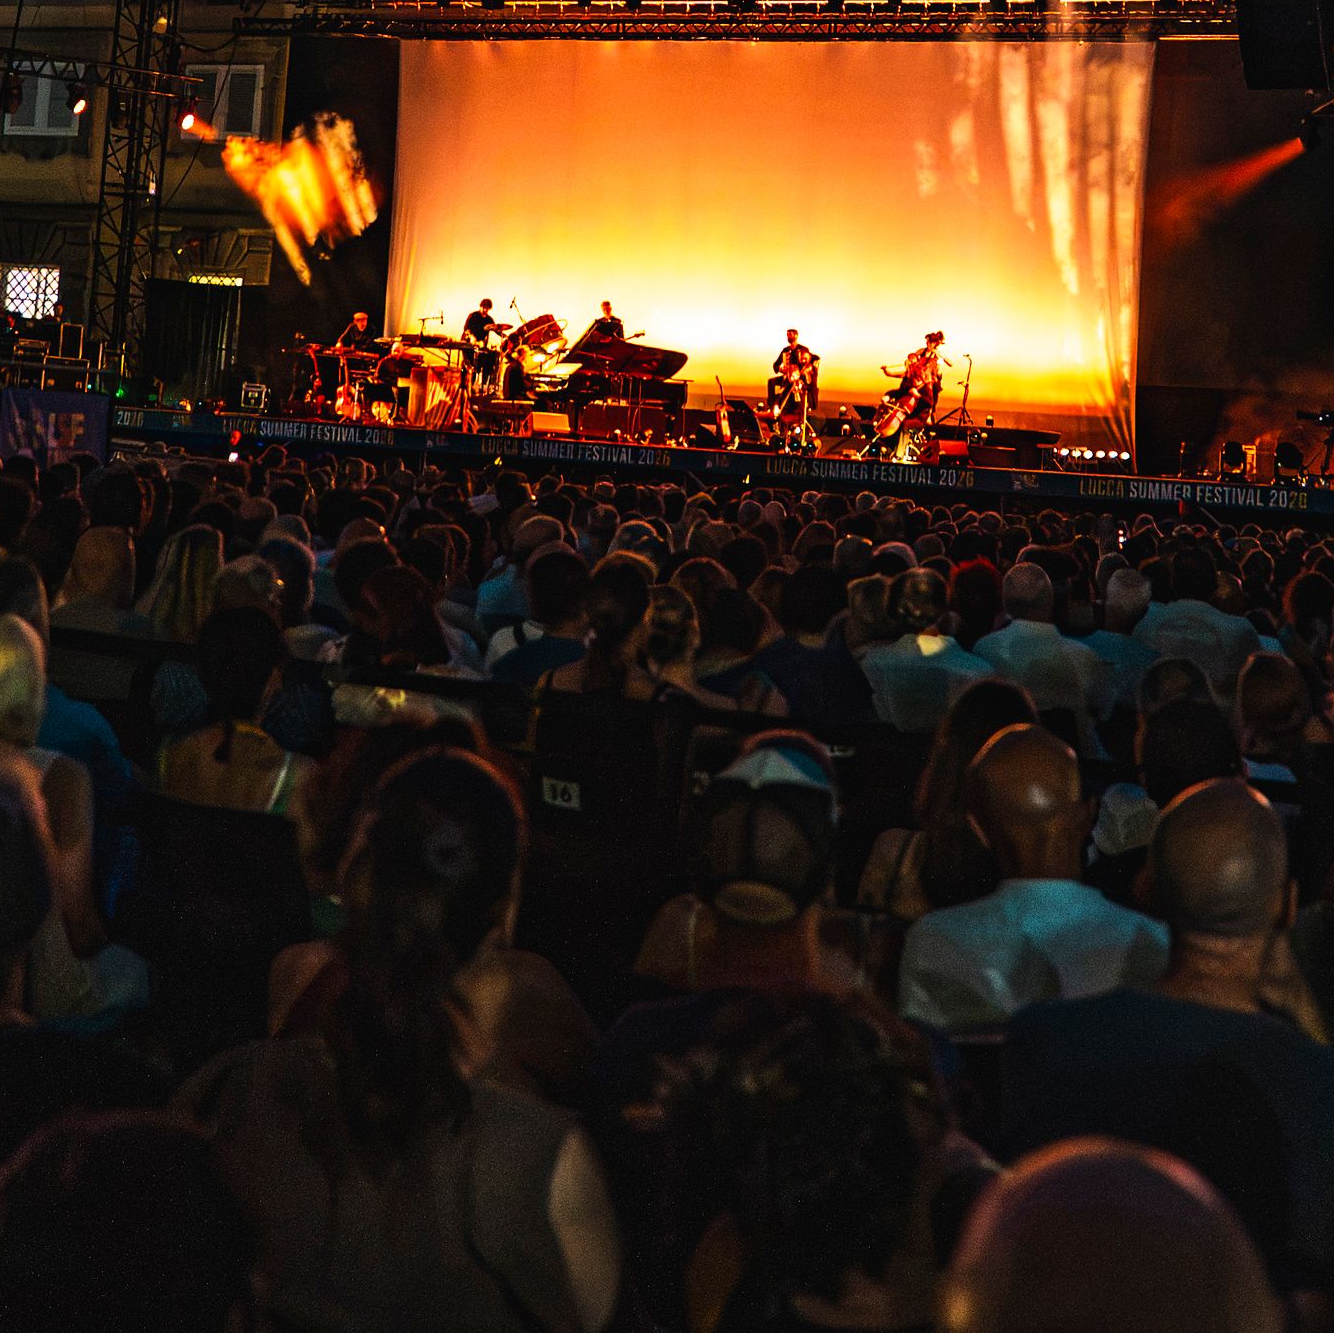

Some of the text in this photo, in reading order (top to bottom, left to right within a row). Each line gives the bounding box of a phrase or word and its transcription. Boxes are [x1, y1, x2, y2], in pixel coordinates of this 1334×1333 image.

[259, 421, 307, 440] SUMMER
[310, 424, 362, 444] FESTIVAL
[481, 437, 671, 466] LUCCA SUMMER FESTIVAL 2026
[766, 456, 974, 488] LUCCA SUMMER FESTIVAL 2026
[1080, 477, 1308, 510] LUCCA SUMMER FESTIVAL 2026
